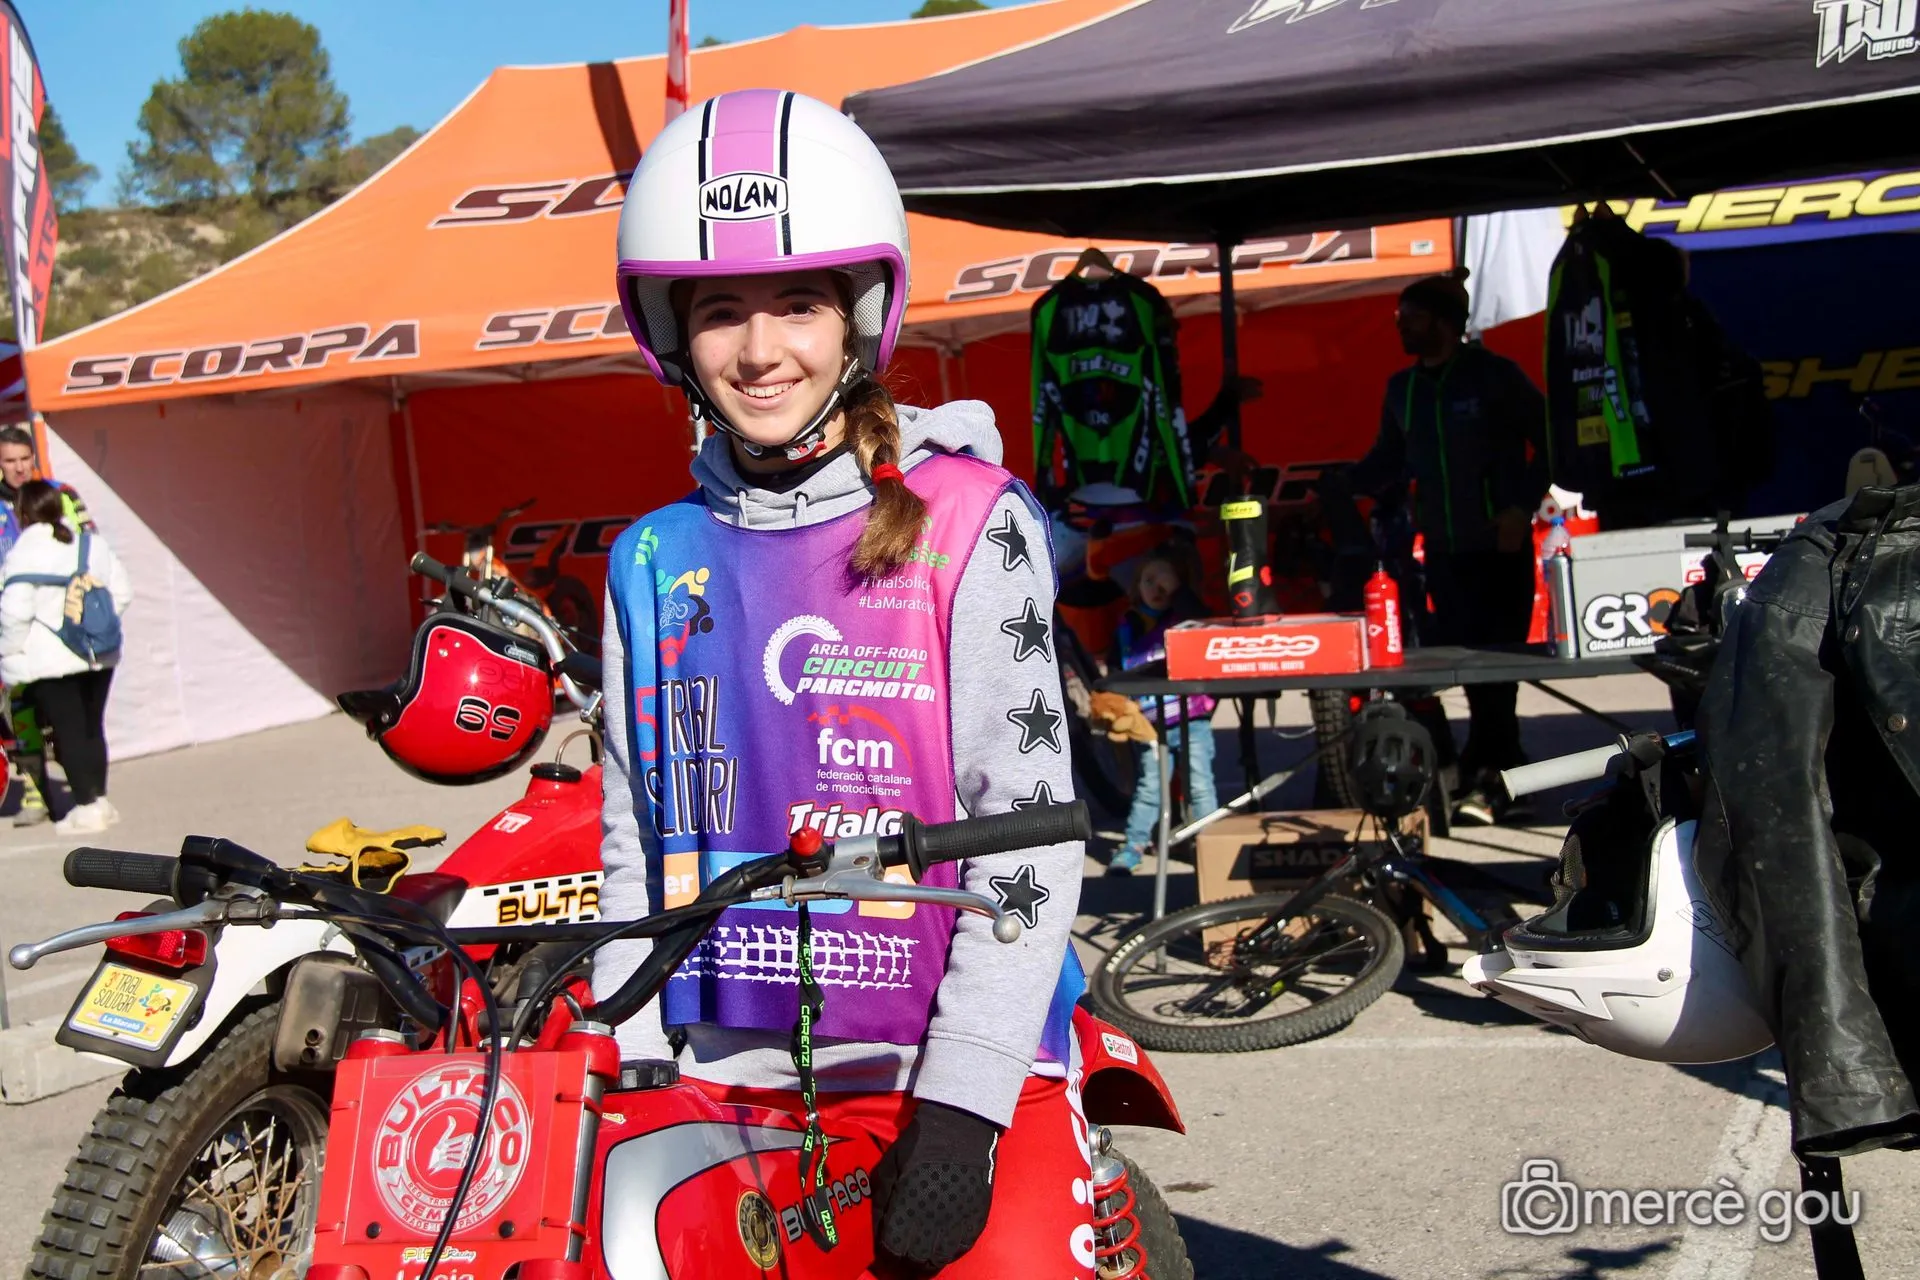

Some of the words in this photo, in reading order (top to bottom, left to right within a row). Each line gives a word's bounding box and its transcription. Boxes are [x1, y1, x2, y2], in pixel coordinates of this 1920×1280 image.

[705, 176, 779, 214] NOLAN
[65, 320, 420, 393] SCORPA
[1760, 346, 1920, 400] SHE
[809, 643, 849, 657] AREA
[854, 645, 928, 662] OFF-ROAD
[1588, 636, 1626, 652] Global
[802, 657, 924, 681] CIRCUIT
[817, 727, 894, 769] fcm
[816, 782, 828, 792] de
[832, 782, 901, 797] motociclisme
[817, 768, 865, 782] federació
[867, 771, 912, 785] catalana
[498, 884, 600, 925] BULTA
[801, 1005, 811, 1068] CARENZI
[403, 1212, 429, 1230] MADE
